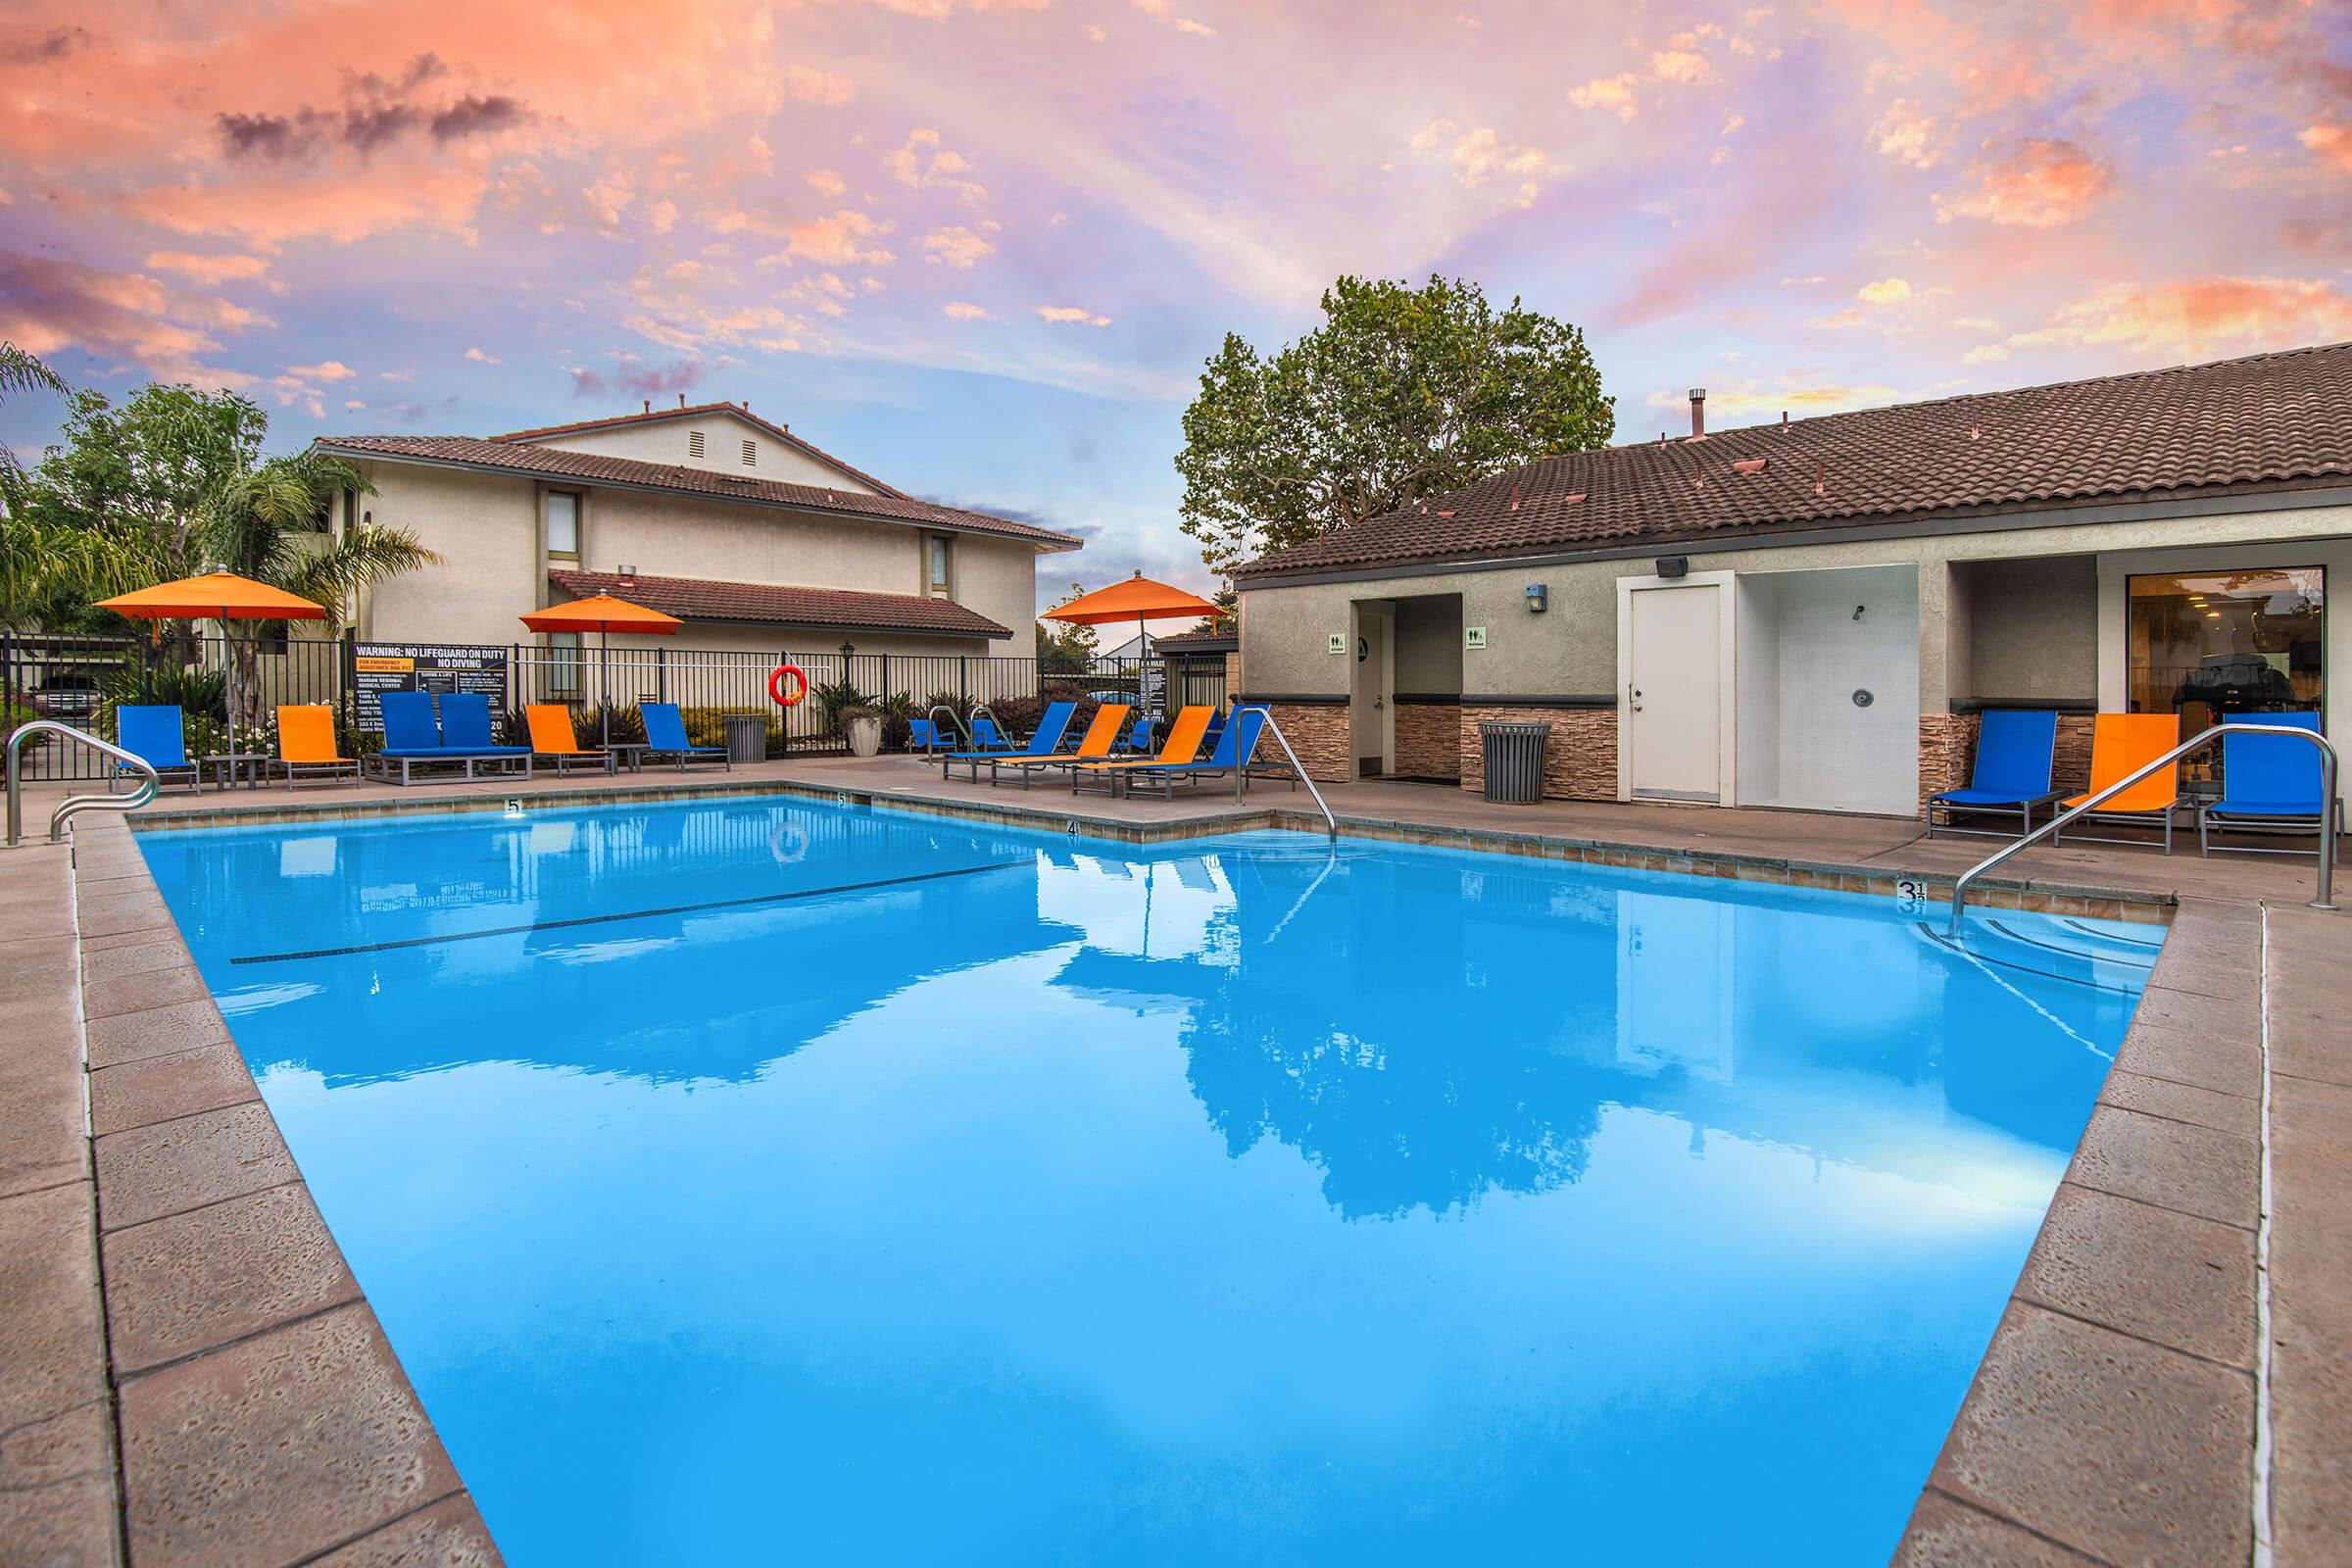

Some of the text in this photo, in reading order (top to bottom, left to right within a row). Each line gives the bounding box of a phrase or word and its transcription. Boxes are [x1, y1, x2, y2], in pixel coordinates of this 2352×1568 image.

[356, 646, 505, 660] WARNING: NO LIFEGUARD ON DUTY
[437, 659, 482, 668] NO DIVING
[490, 720, 503, 730] 20
[508, 799, 519, 813] 5
